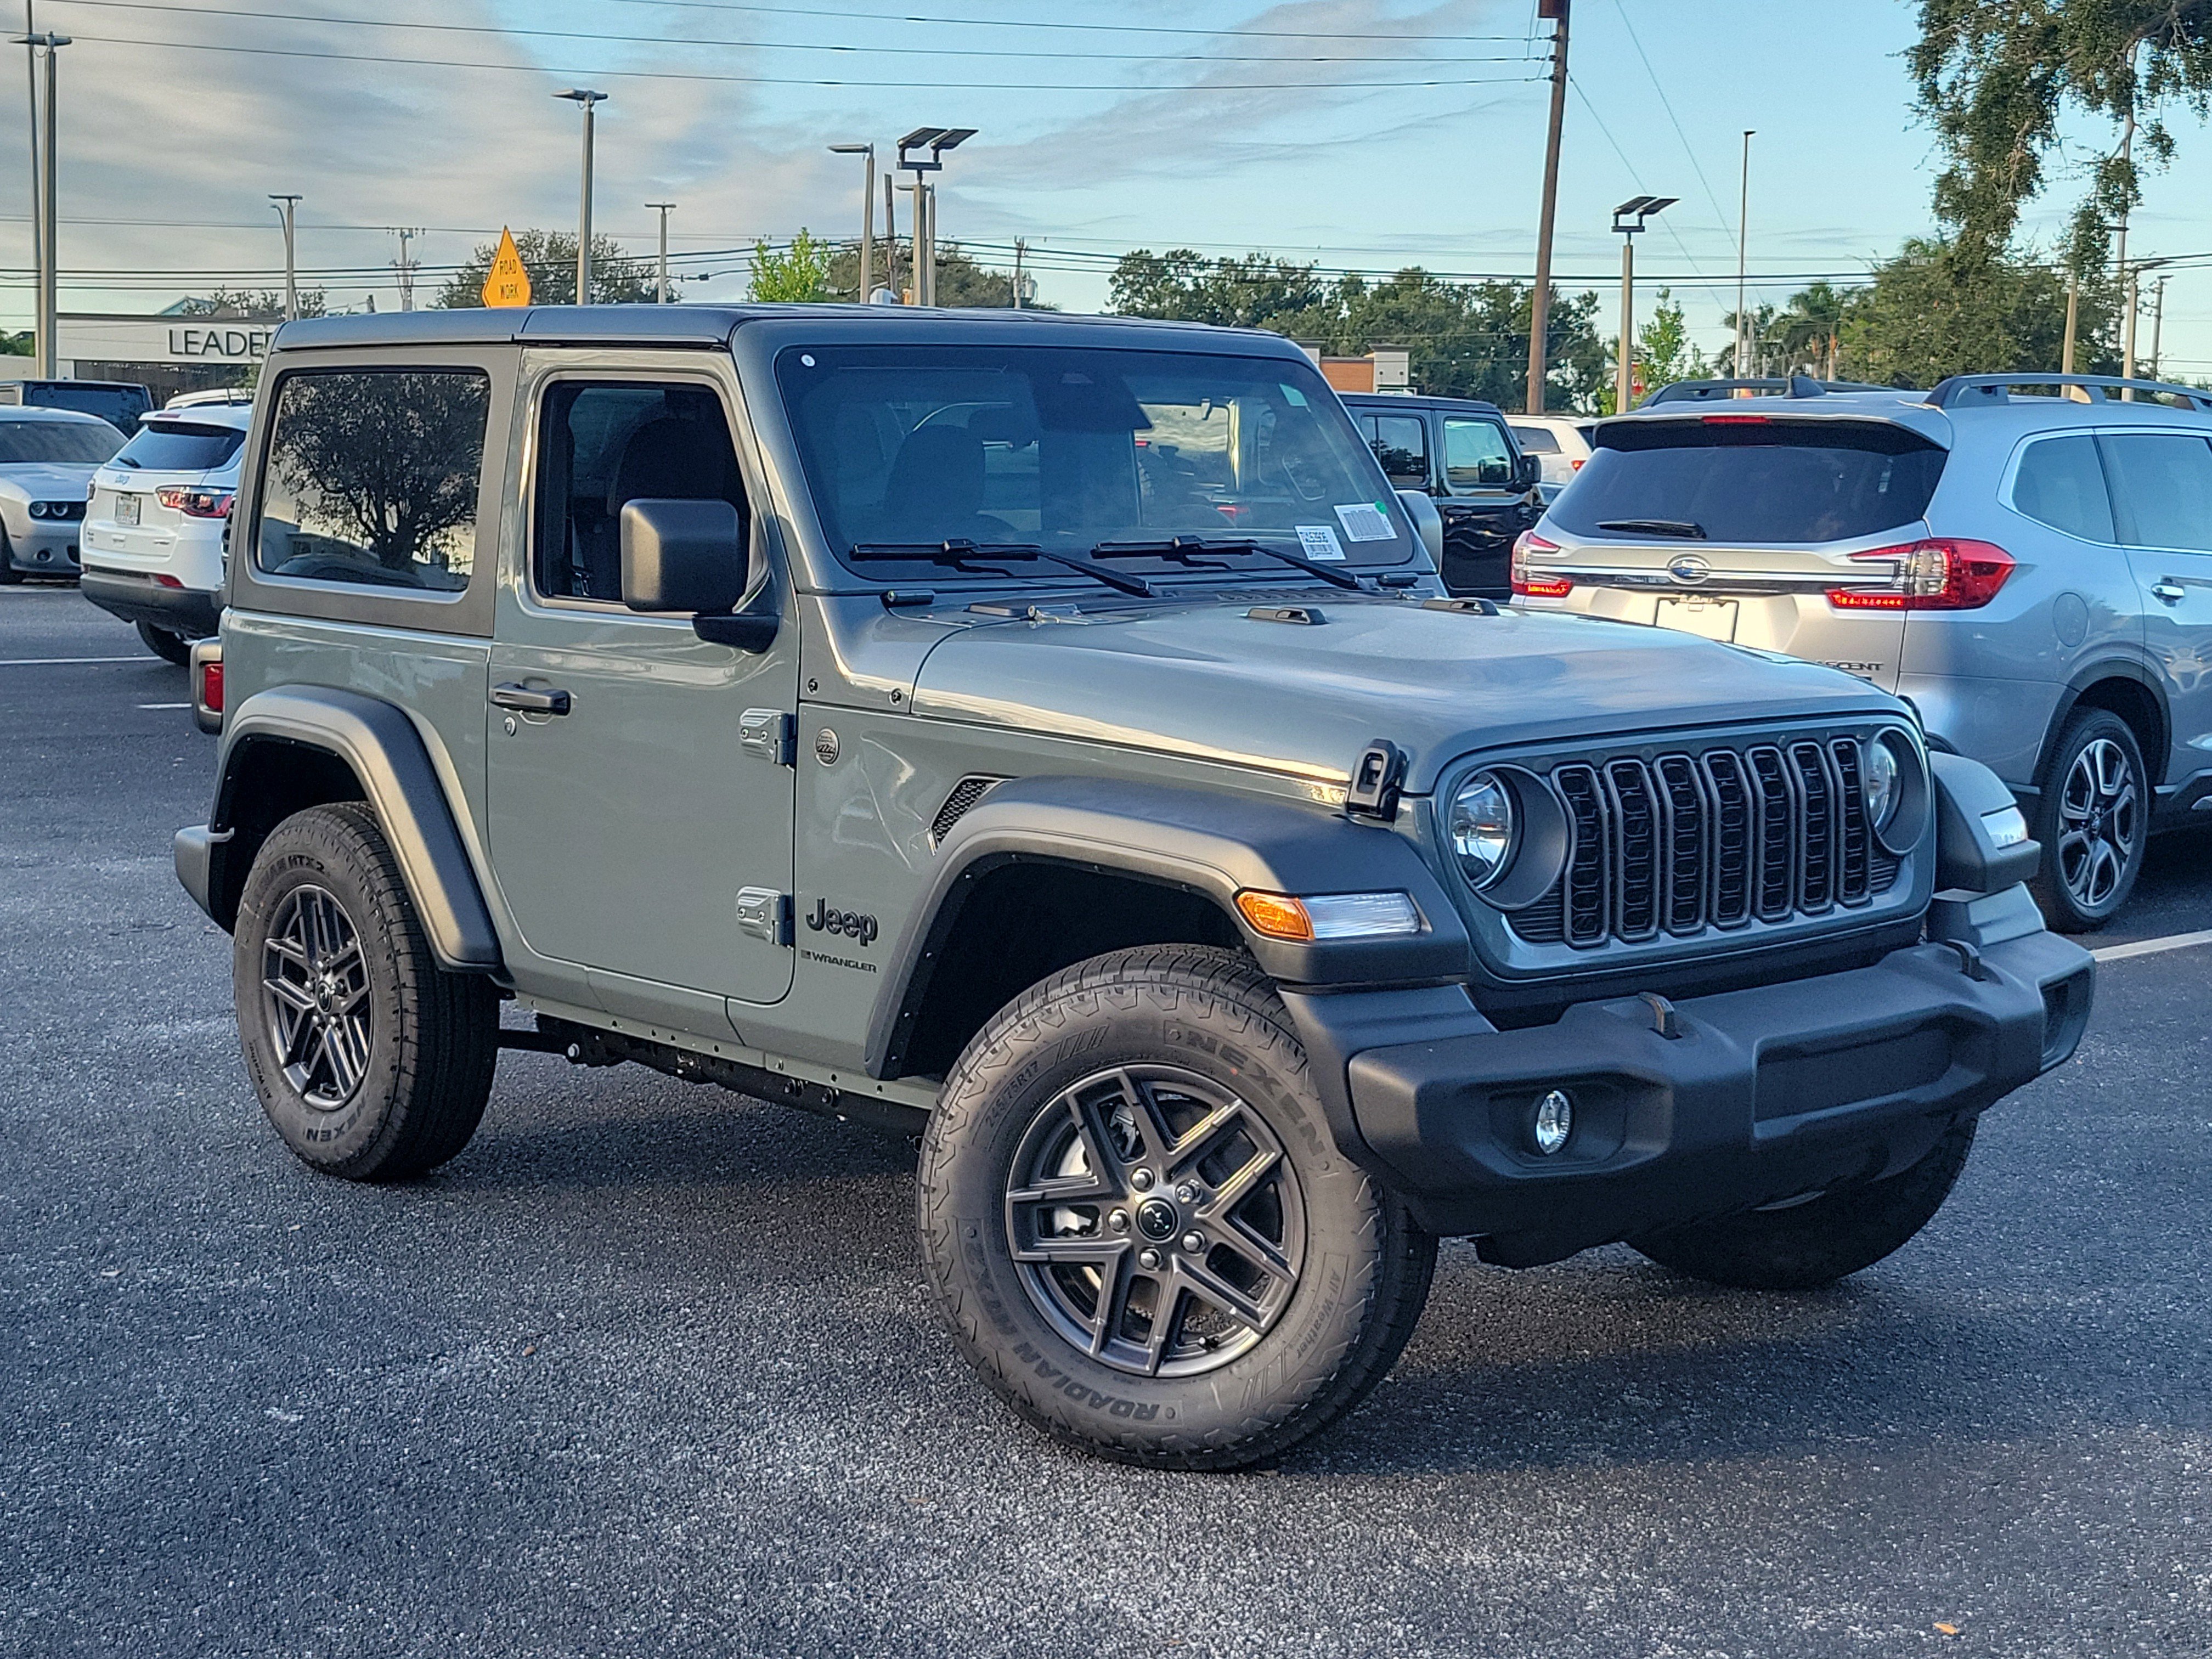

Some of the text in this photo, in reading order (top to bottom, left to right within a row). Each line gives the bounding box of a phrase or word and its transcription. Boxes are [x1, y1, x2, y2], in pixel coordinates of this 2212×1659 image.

[500, 259, 517, 275] ROAD
[500, 283, 518, 299] WORK
[1817, 661, 1884, 671] SCENT
[806, 898, 878, 947] Jeep
[811, 951, 877, 973] WRANGLER
[985, 1060, 1040, 1128] 245/75R17
[1187, 1030, 1326, 1156] NEXEN
[306, 1098, 366, 1142] NEXEN
[1013, 1342, 1160, 1421] ROADIAN
